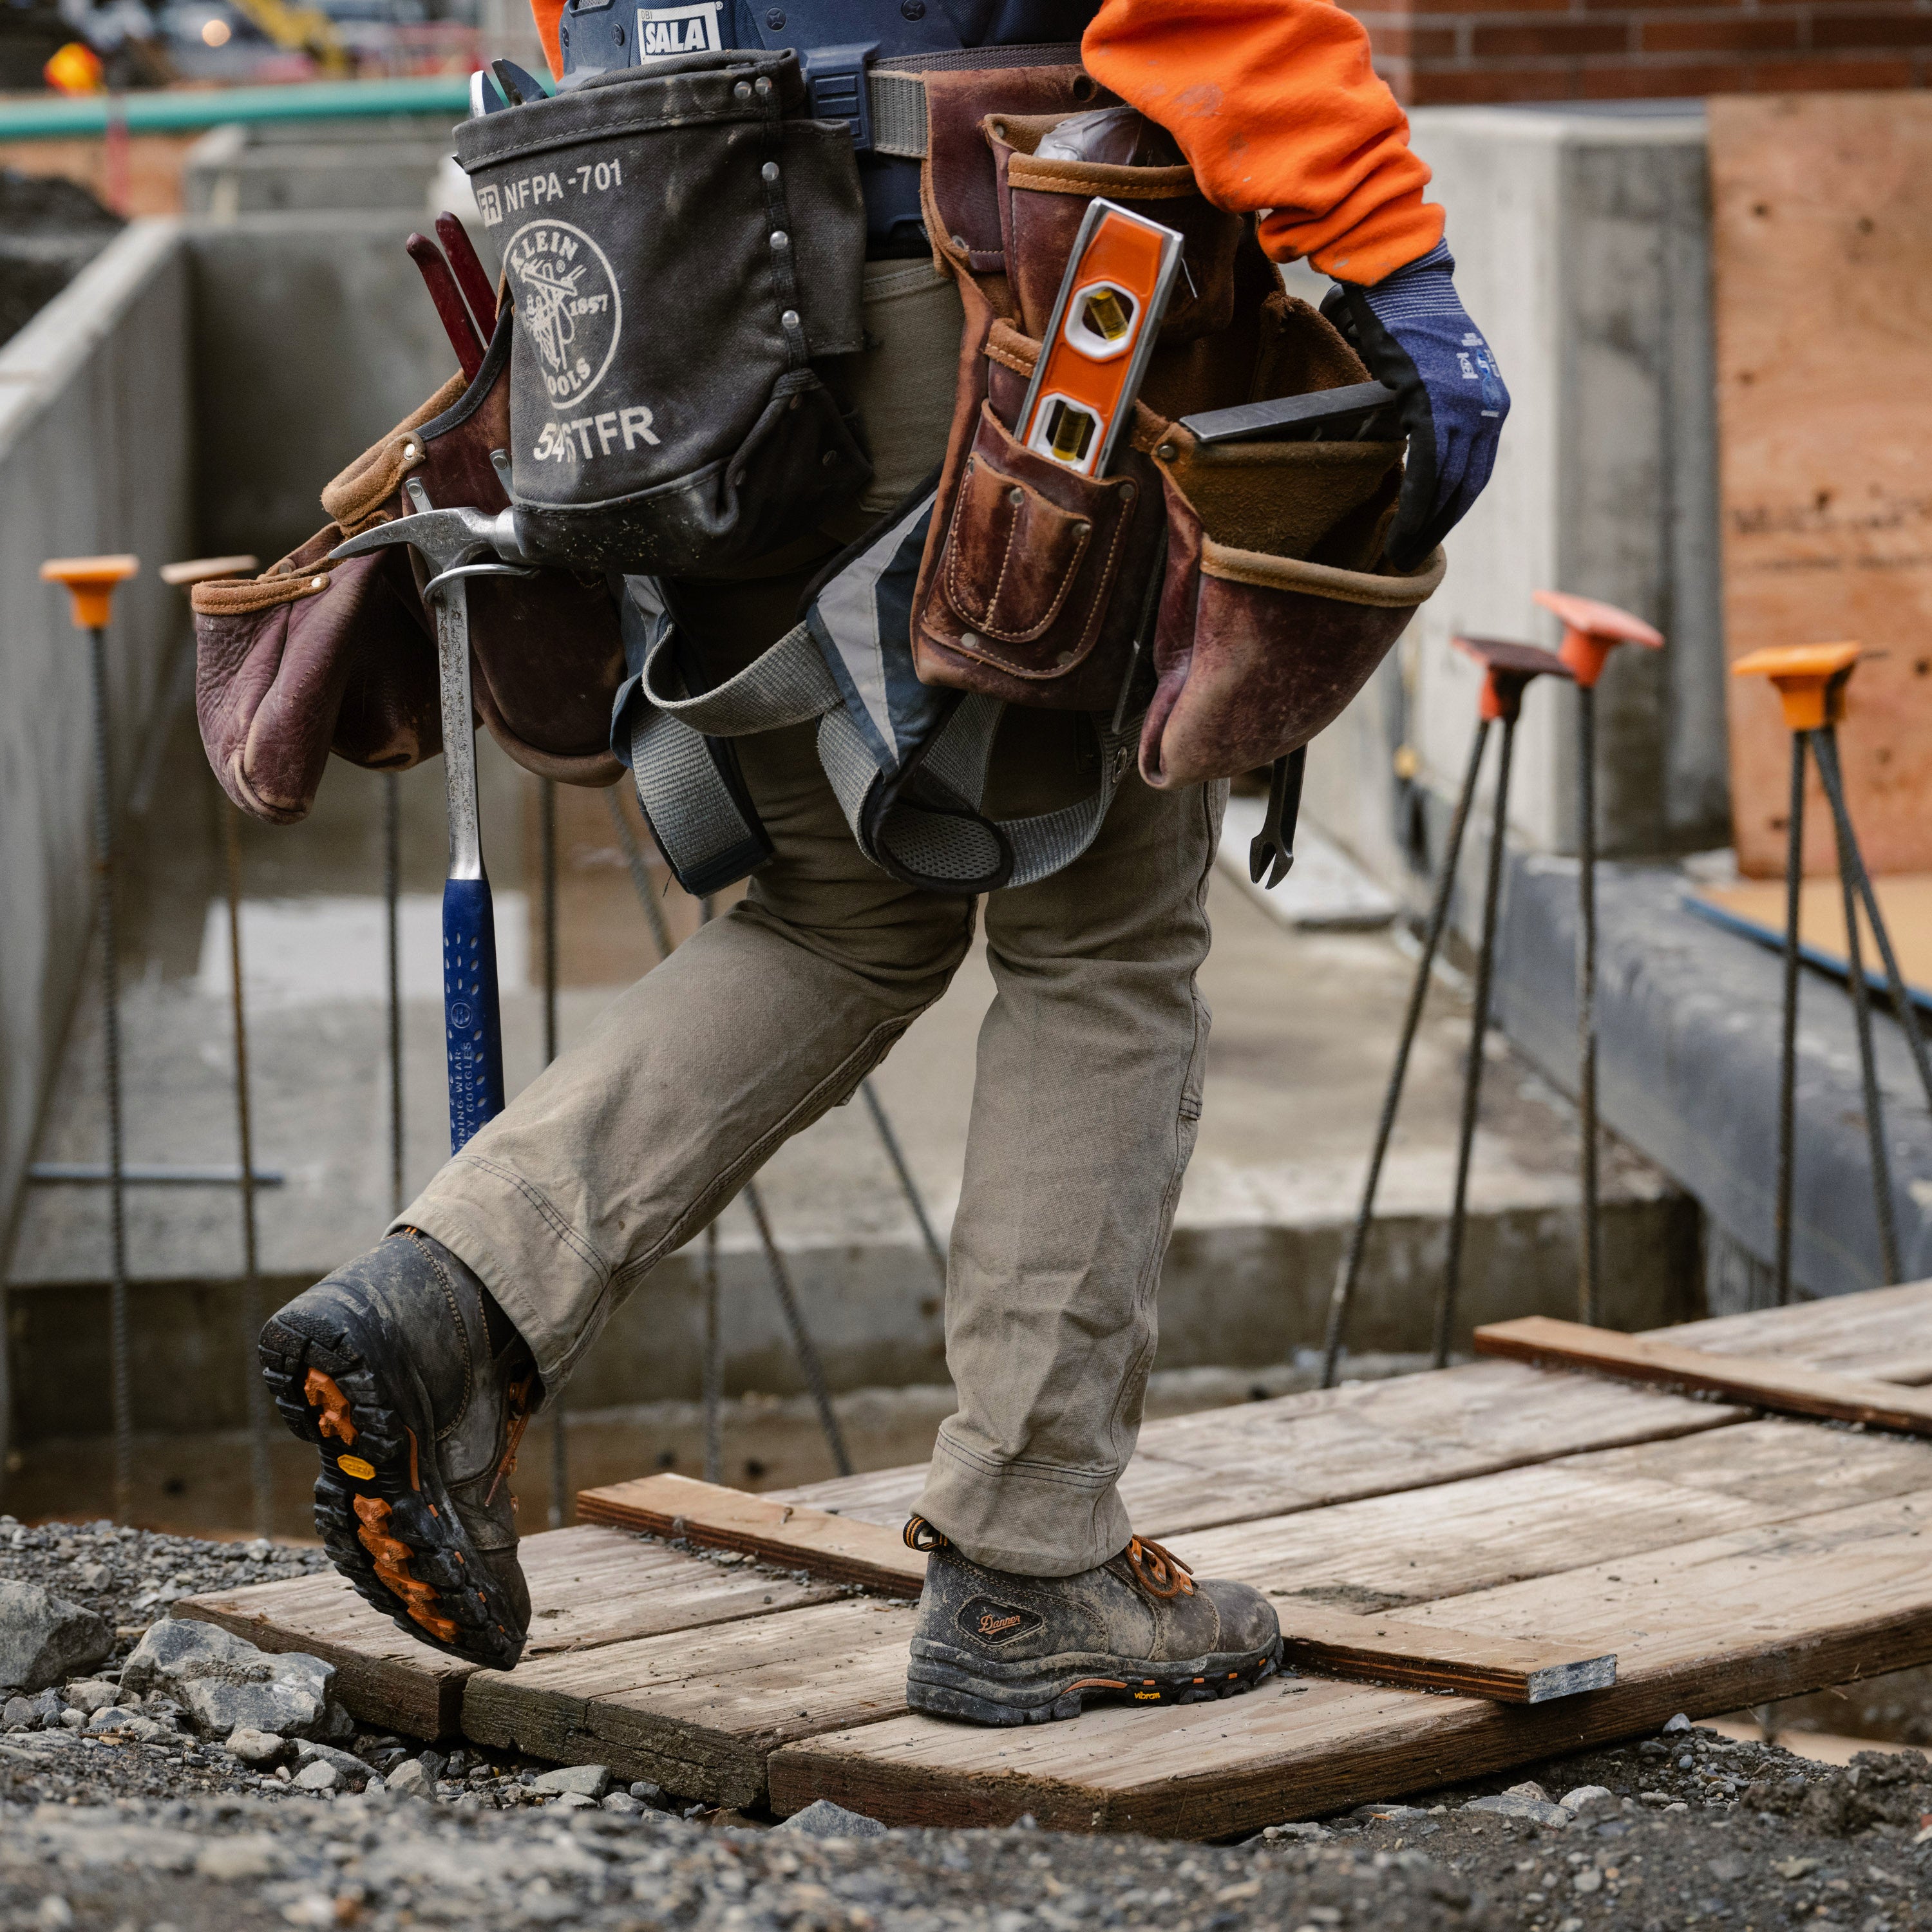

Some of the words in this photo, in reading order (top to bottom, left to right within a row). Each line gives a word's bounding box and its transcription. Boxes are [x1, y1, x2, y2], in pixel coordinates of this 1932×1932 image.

[641, 10, 652, 20] DBI
[645, 18, 706, 54] SALA
[504, 172, 564, 213] NFPA
[511, 231, 578, 274] KLEIN
[542, 357, 591, 396] OOLS
[462, 1042, 475, 1113] GOGGLES
[978, 1613, 1021, 1633] Danner
[1134, 1691, 1160, 1700] vibram
